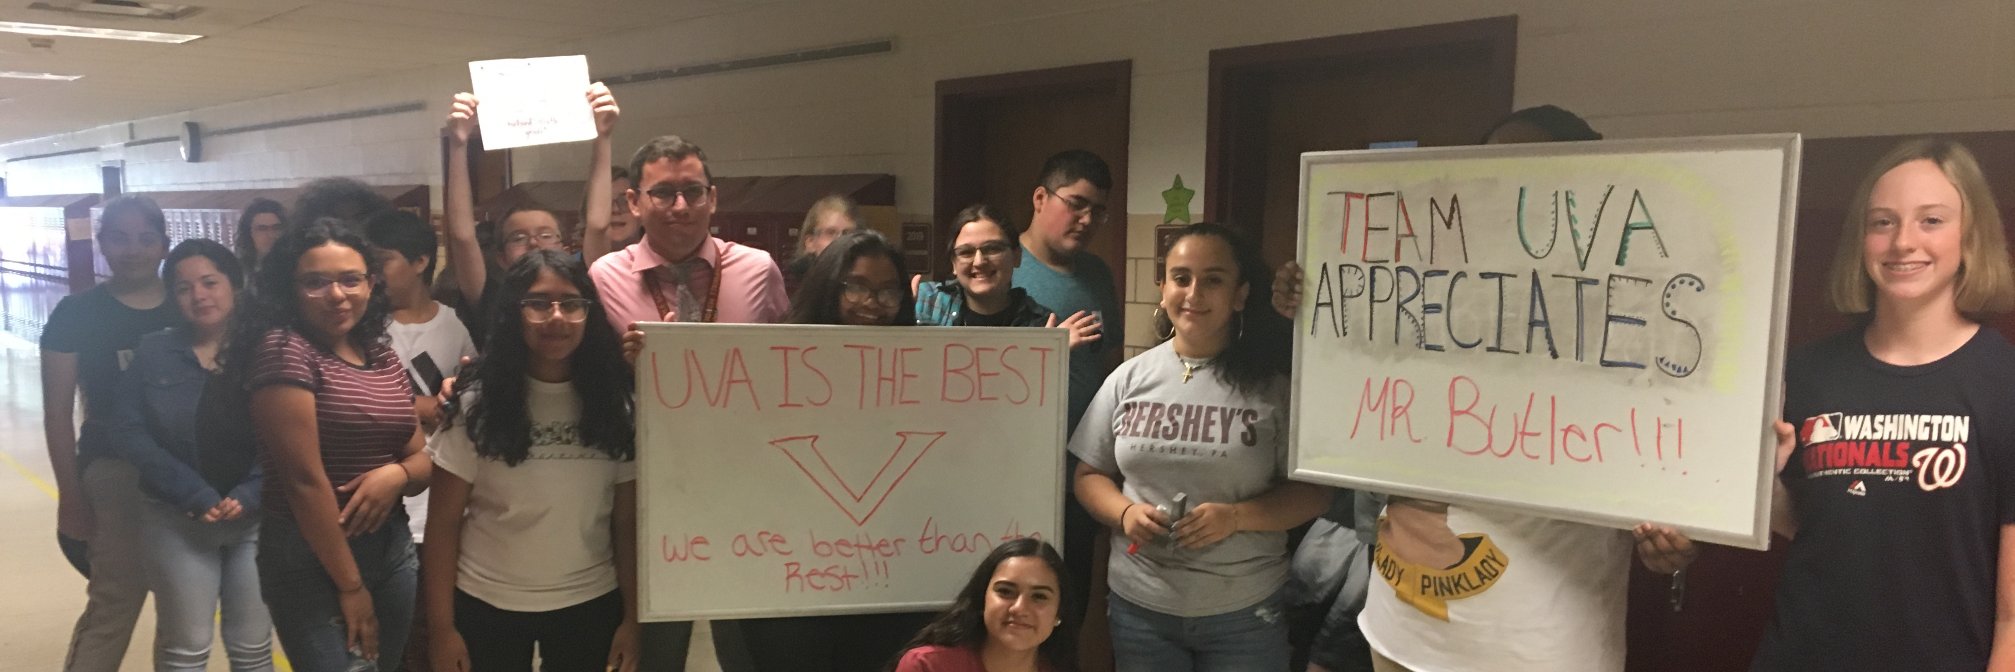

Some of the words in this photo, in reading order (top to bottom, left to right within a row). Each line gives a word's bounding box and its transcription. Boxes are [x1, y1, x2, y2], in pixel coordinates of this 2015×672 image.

[1327, 191, 1469, 265] TEAM
[1516, 185, 1669, 271] UVA
[1310, 262, 1706, 378] APPRECIATES
[651, 347, 761, 410] UVA
[770, 346, 833, 407] IS
[844, 344, 923, 410] THE
[940, 343, 1054, 407] BEST
[1118, 401, 1259, 447] HERSHEY'S
[1844, 414, 1970, 443] WASHINGTON
[1211, 449, 1228, 458] PA
[662, 531, 711, 563] we
[731, 529, 793, 558] are
[810, 528, 906, 559] better
[917, 516, 993, 555] than
